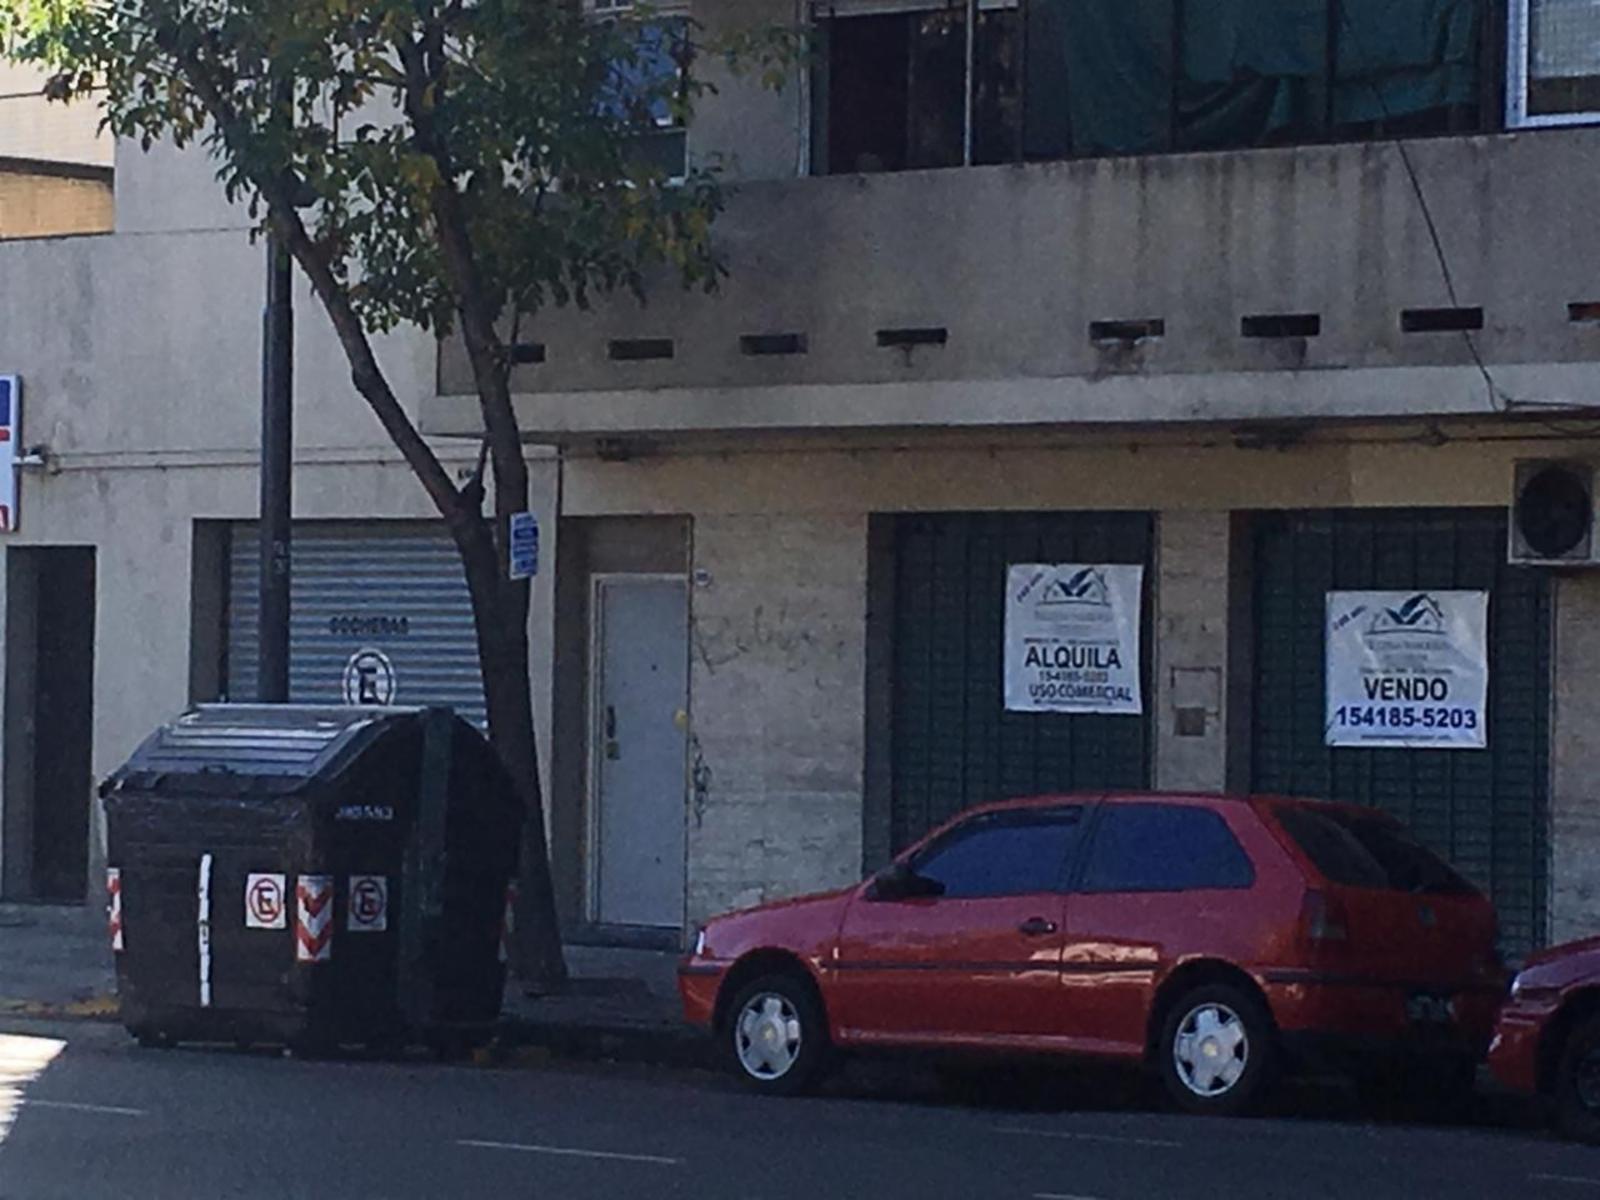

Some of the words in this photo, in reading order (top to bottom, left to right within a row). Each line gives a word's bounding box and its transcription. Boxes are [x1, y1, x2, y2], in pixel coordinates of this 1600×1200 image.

[1025, 646, 1121, 669] ALQUILA
[1029, 683, 1056, 698] USO
[1058, 683, 1132, 702] COMERCIAL
[1364, 677, 1448, 700] VENDO
[1336, 706, 1477, 729] 154185-5203
